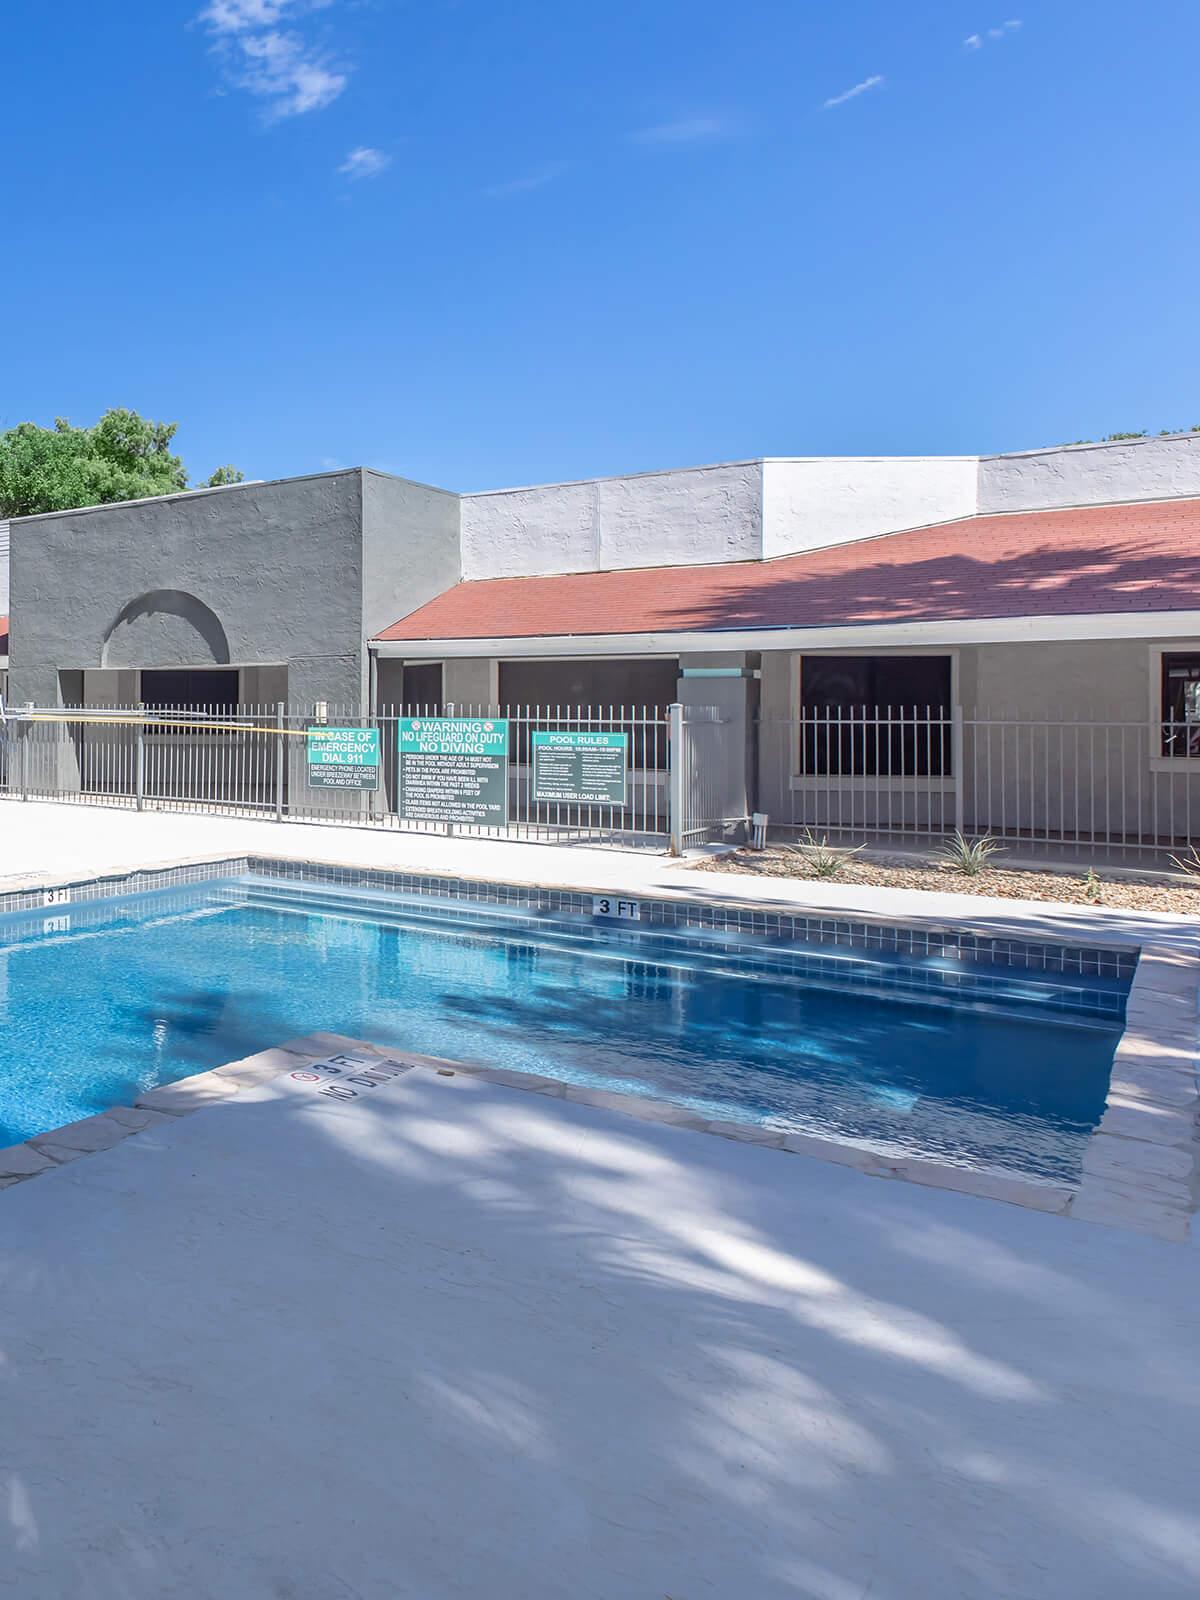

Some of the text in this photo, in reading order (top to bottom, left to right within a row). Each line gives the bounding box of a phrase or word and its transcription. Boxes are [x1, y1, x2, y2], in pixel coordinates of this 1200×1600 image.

[422, 722, 482, 733] WARNING
[327, 732, 355, 742] CASE
[357, 732, 372, 742] OF
[402, 732, 504, 743] NO LIFEGUARD ON DUTY
[550, 736, 576, 744] POOL
[311, 742, 376, 753] EMERGENCY
[419, 742, 484, 753] NO DIVING
[322, 753, 363, 764] DIAL 911
[48, 888, 68, 902] 3 FT
[600, 899, 636, 917] 3 FT
[312, 1055, 365, 1074] 3 FT
[317, 1085, 359, 1102] NO
